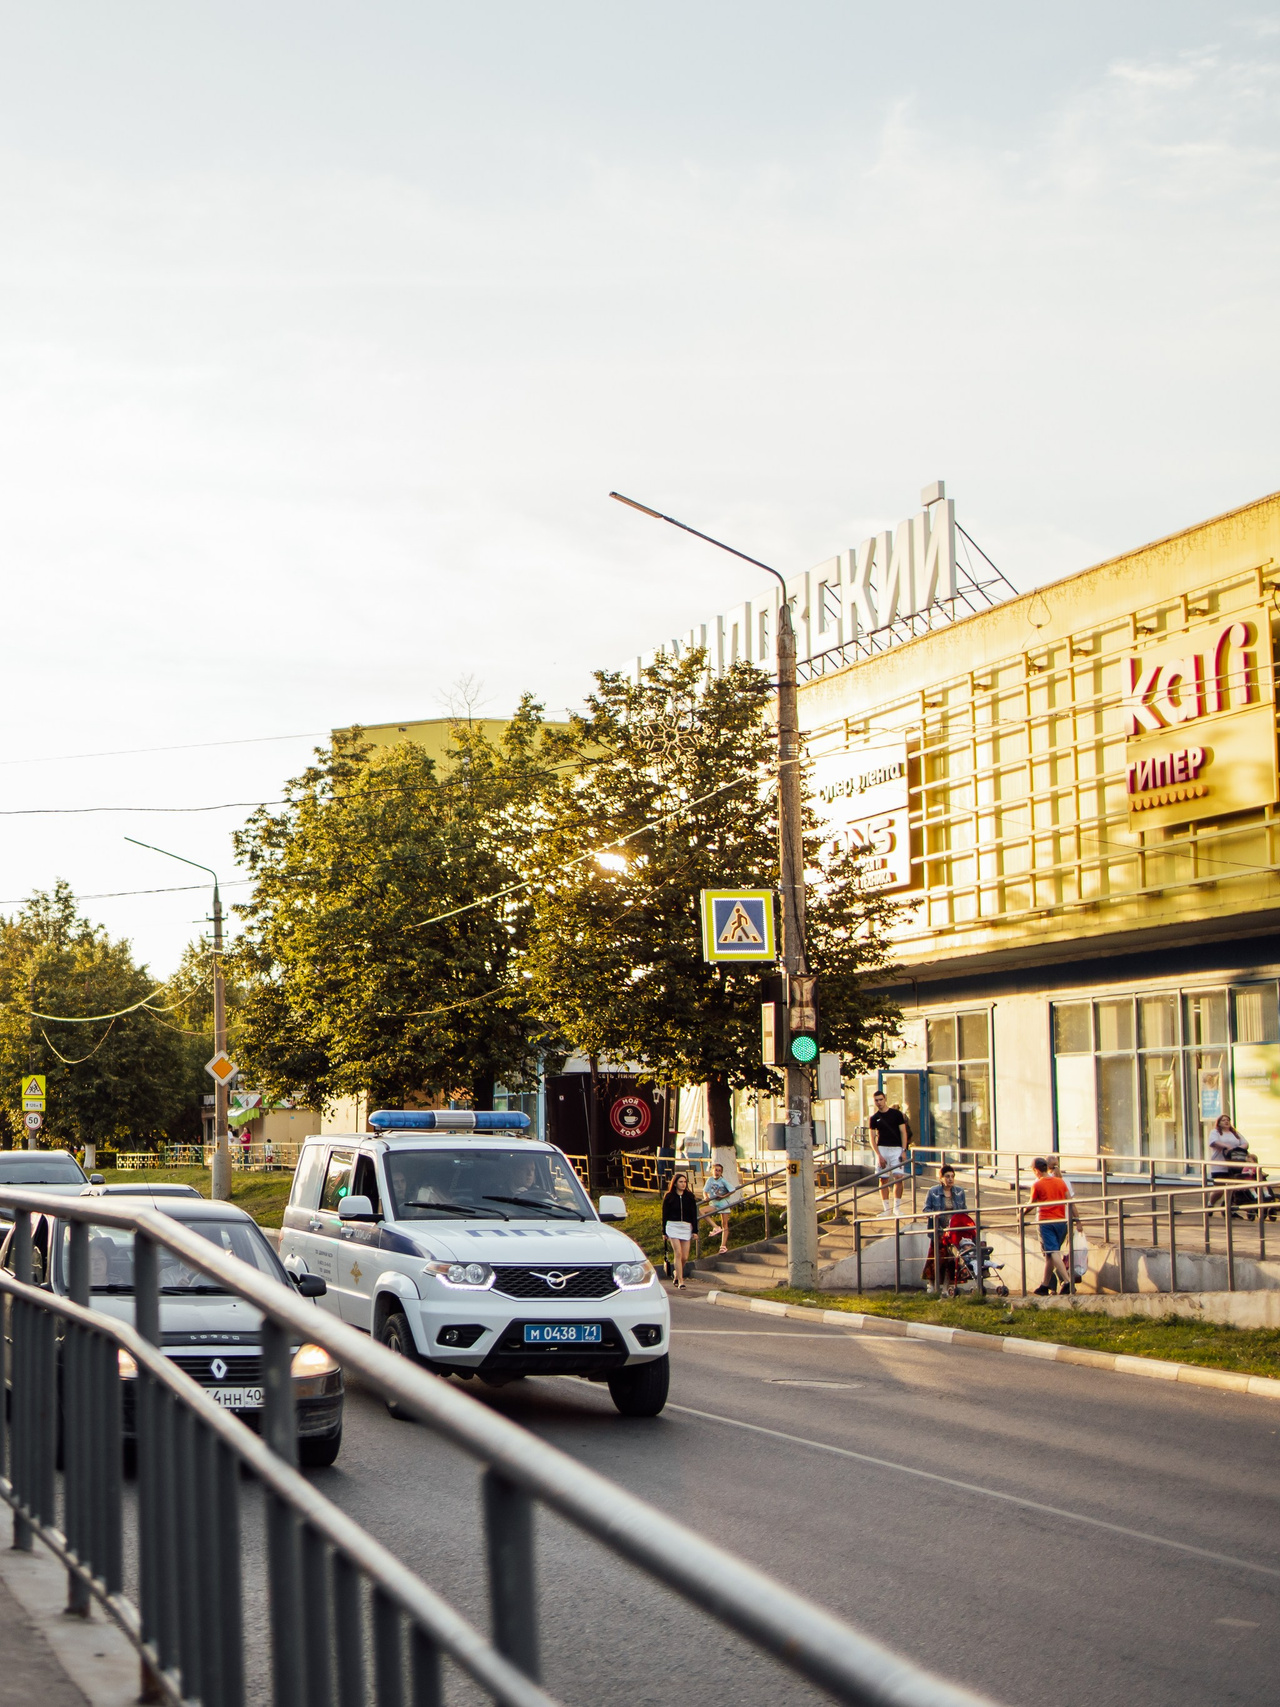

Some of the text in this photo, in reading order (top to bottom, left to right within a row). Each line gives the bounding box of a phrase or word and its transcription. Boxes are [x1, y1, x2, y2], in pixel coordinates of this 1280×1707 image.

[1121, 622, 1252, 736] kari
[1126, 747, 1208, 793] ГИПЕР
[622, 1097, 639, 1105] МОЙ
[620, 1128, 641, 1136] КОФЕ
[464, 1229, 597, 1238] ППС
[543, 1327, 577, 1340] 0438
[584, 1326, 597, 1336] 71
[206, 1389, 262, 1406] 4НН 40
